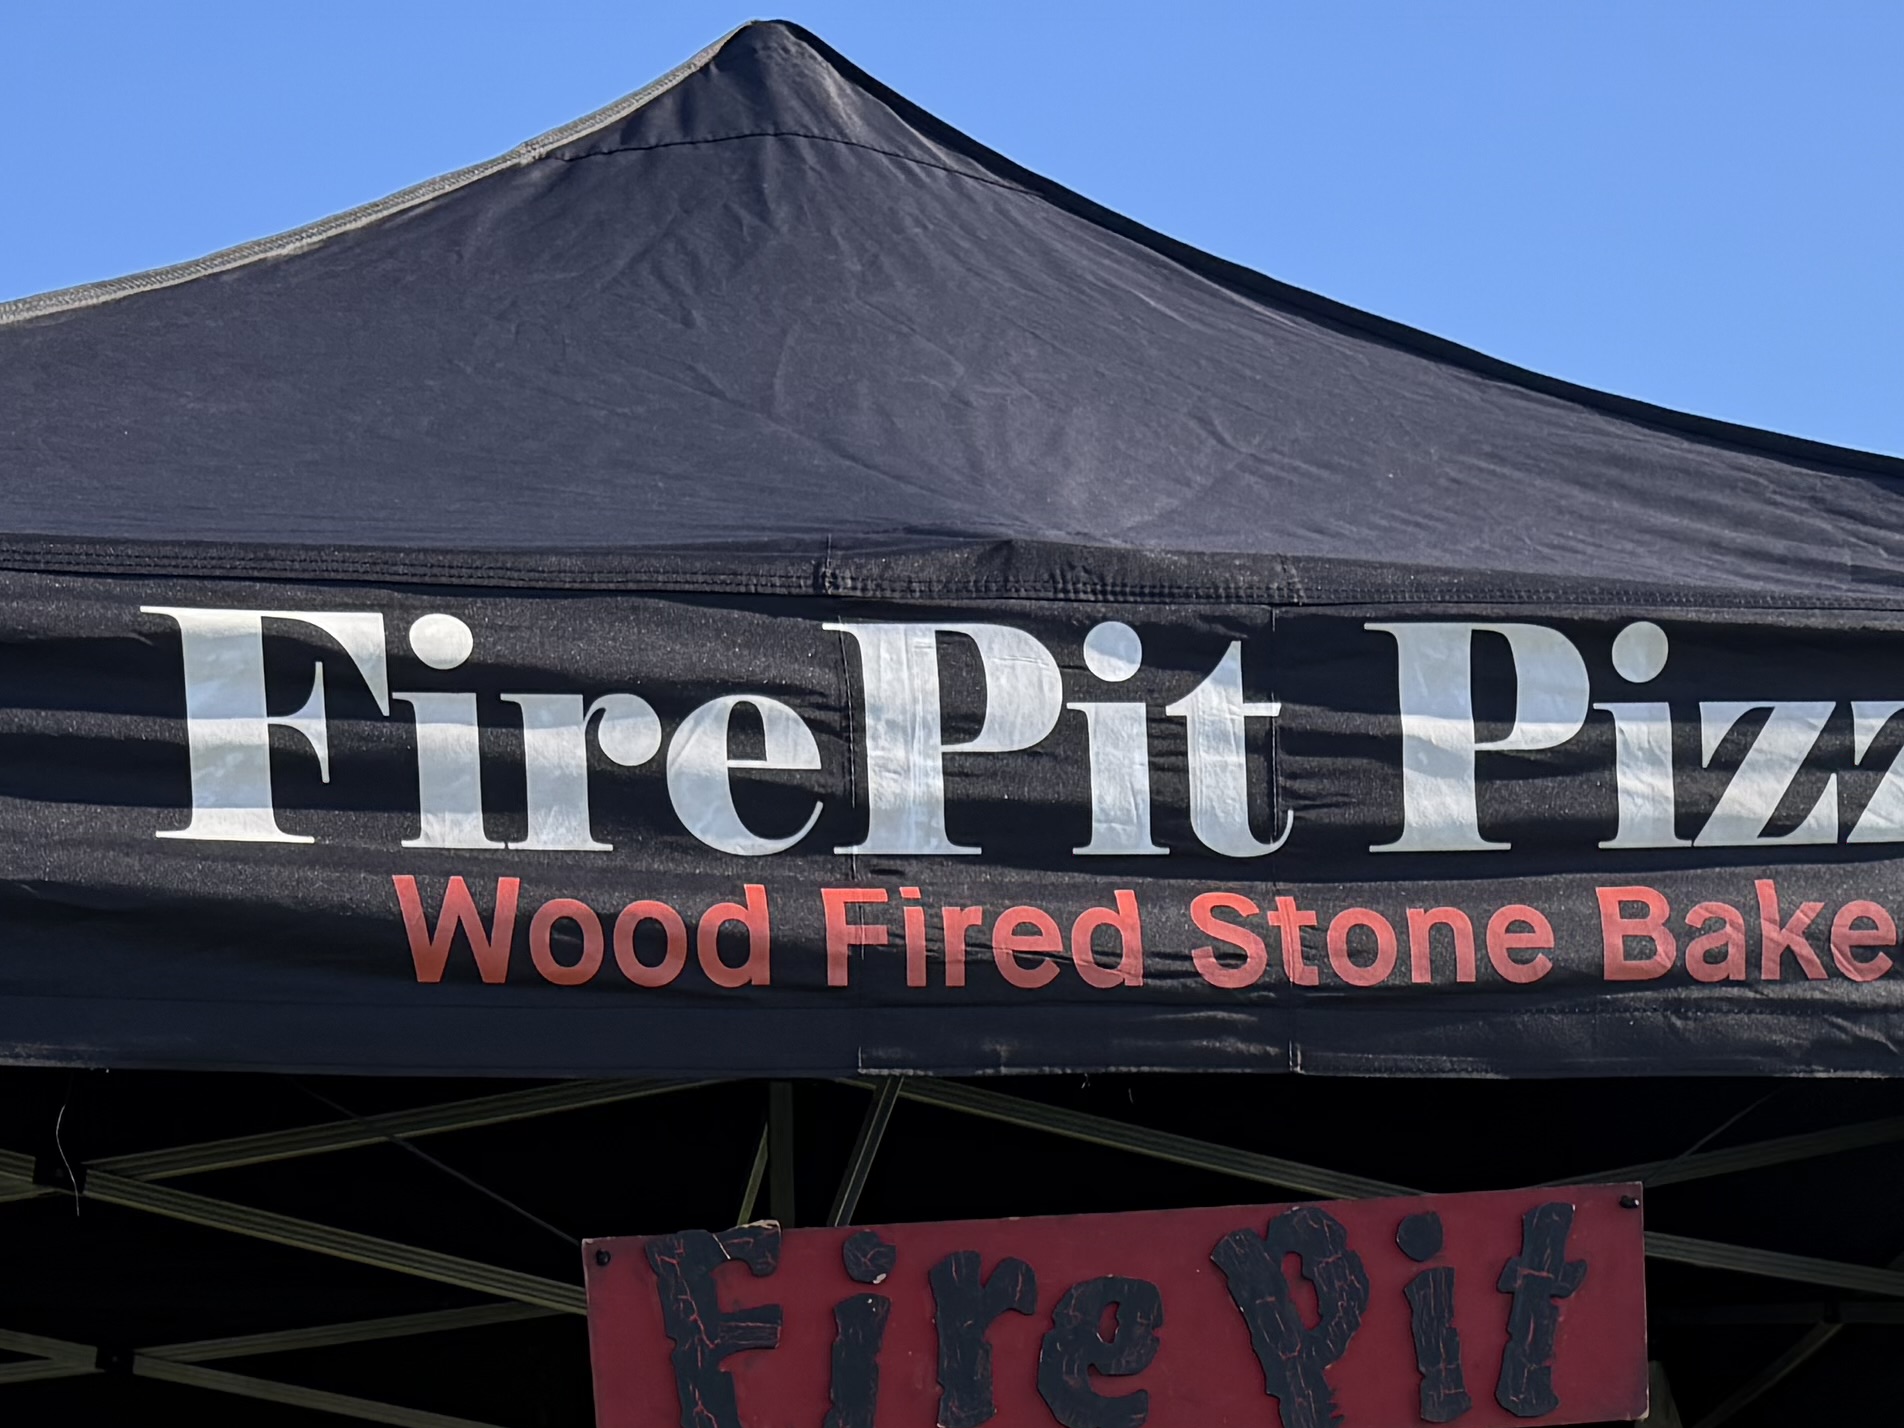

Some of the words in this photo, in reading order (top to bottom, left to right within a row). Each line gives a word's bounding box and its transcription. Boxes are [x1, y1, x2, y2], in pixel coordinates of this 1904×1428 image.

[139, 604, 1294, 857] FirePit
[391, 874, 771, 988] Wood
[819, 884, 1143, 988] Fired
[1190, 885, 1554, 988] Stone
